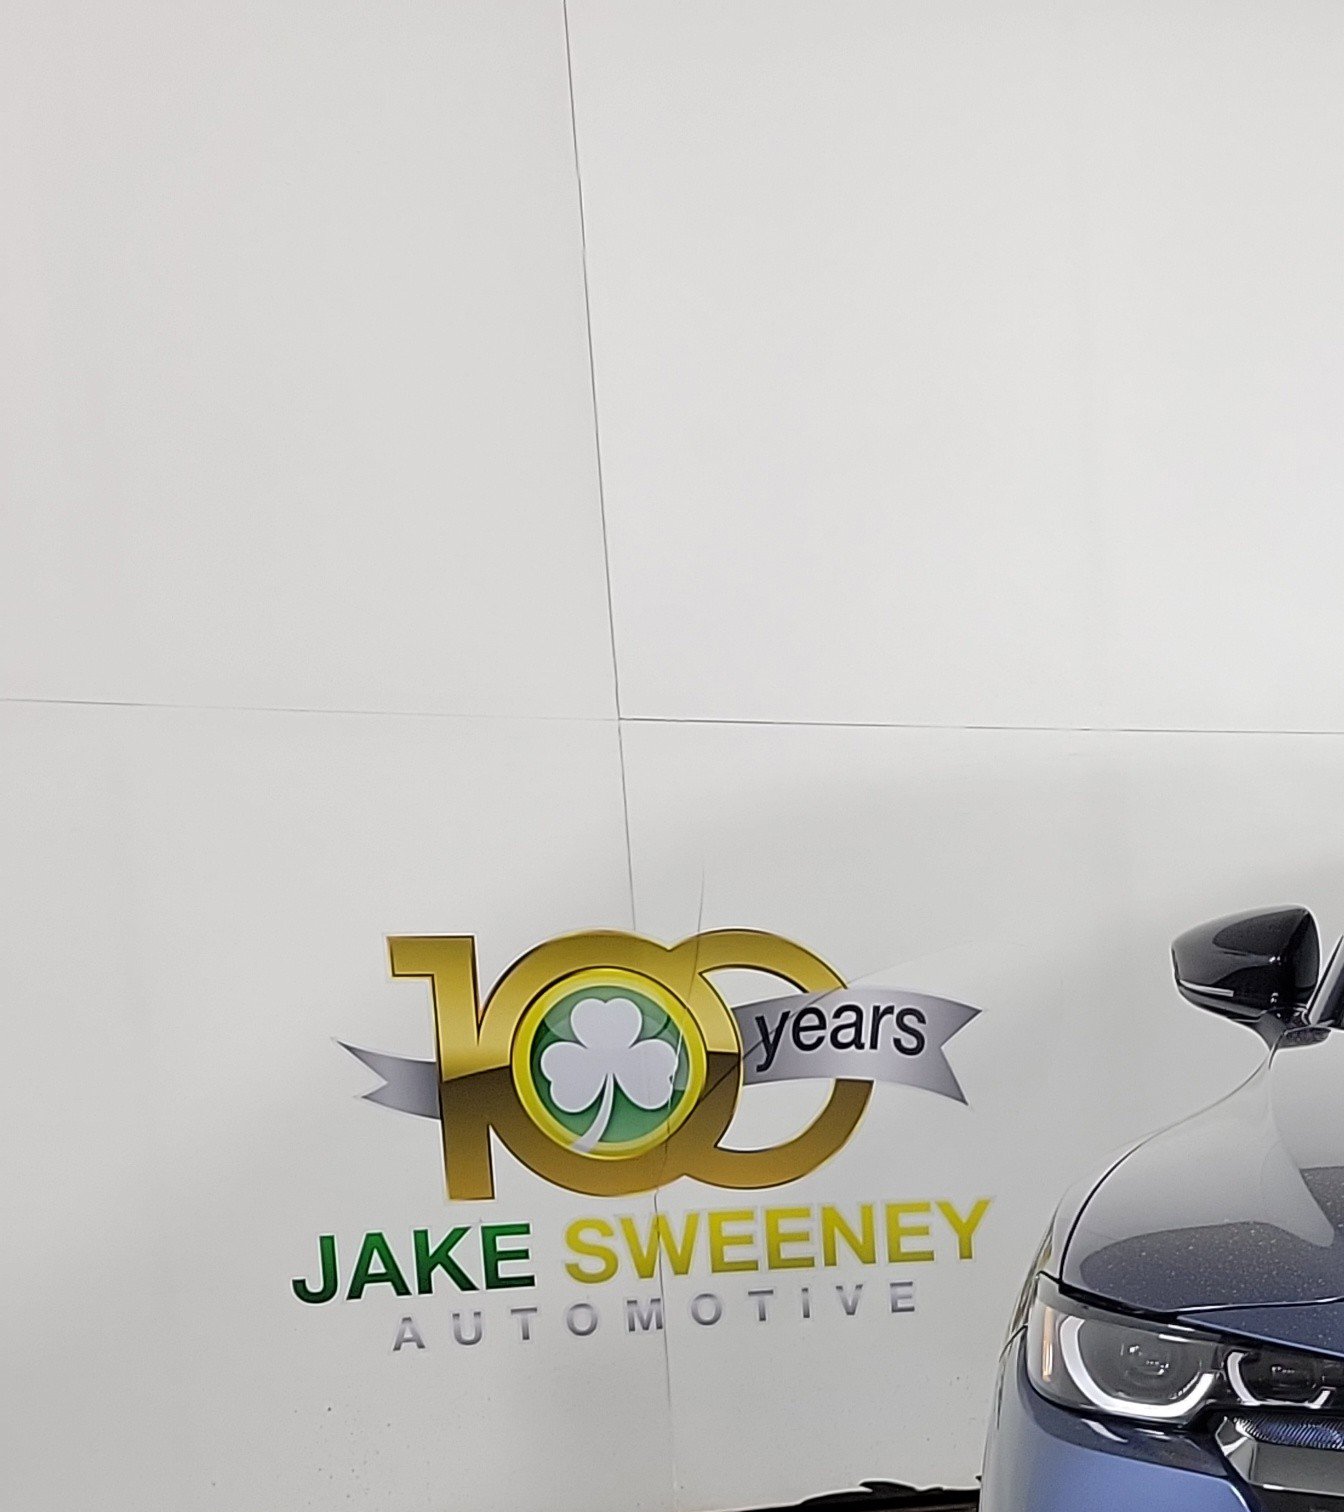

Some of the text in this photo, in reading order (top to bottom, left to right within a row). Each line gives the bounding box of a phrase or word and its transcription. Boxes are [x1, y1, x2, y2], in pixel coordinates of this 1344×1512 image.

[387, 928, 926, 1200] 100 years
[292, 1199, 993, 1305] JAKE SWEENEY
[393, 1281, 915, 1351] AUTOMOTIVE
